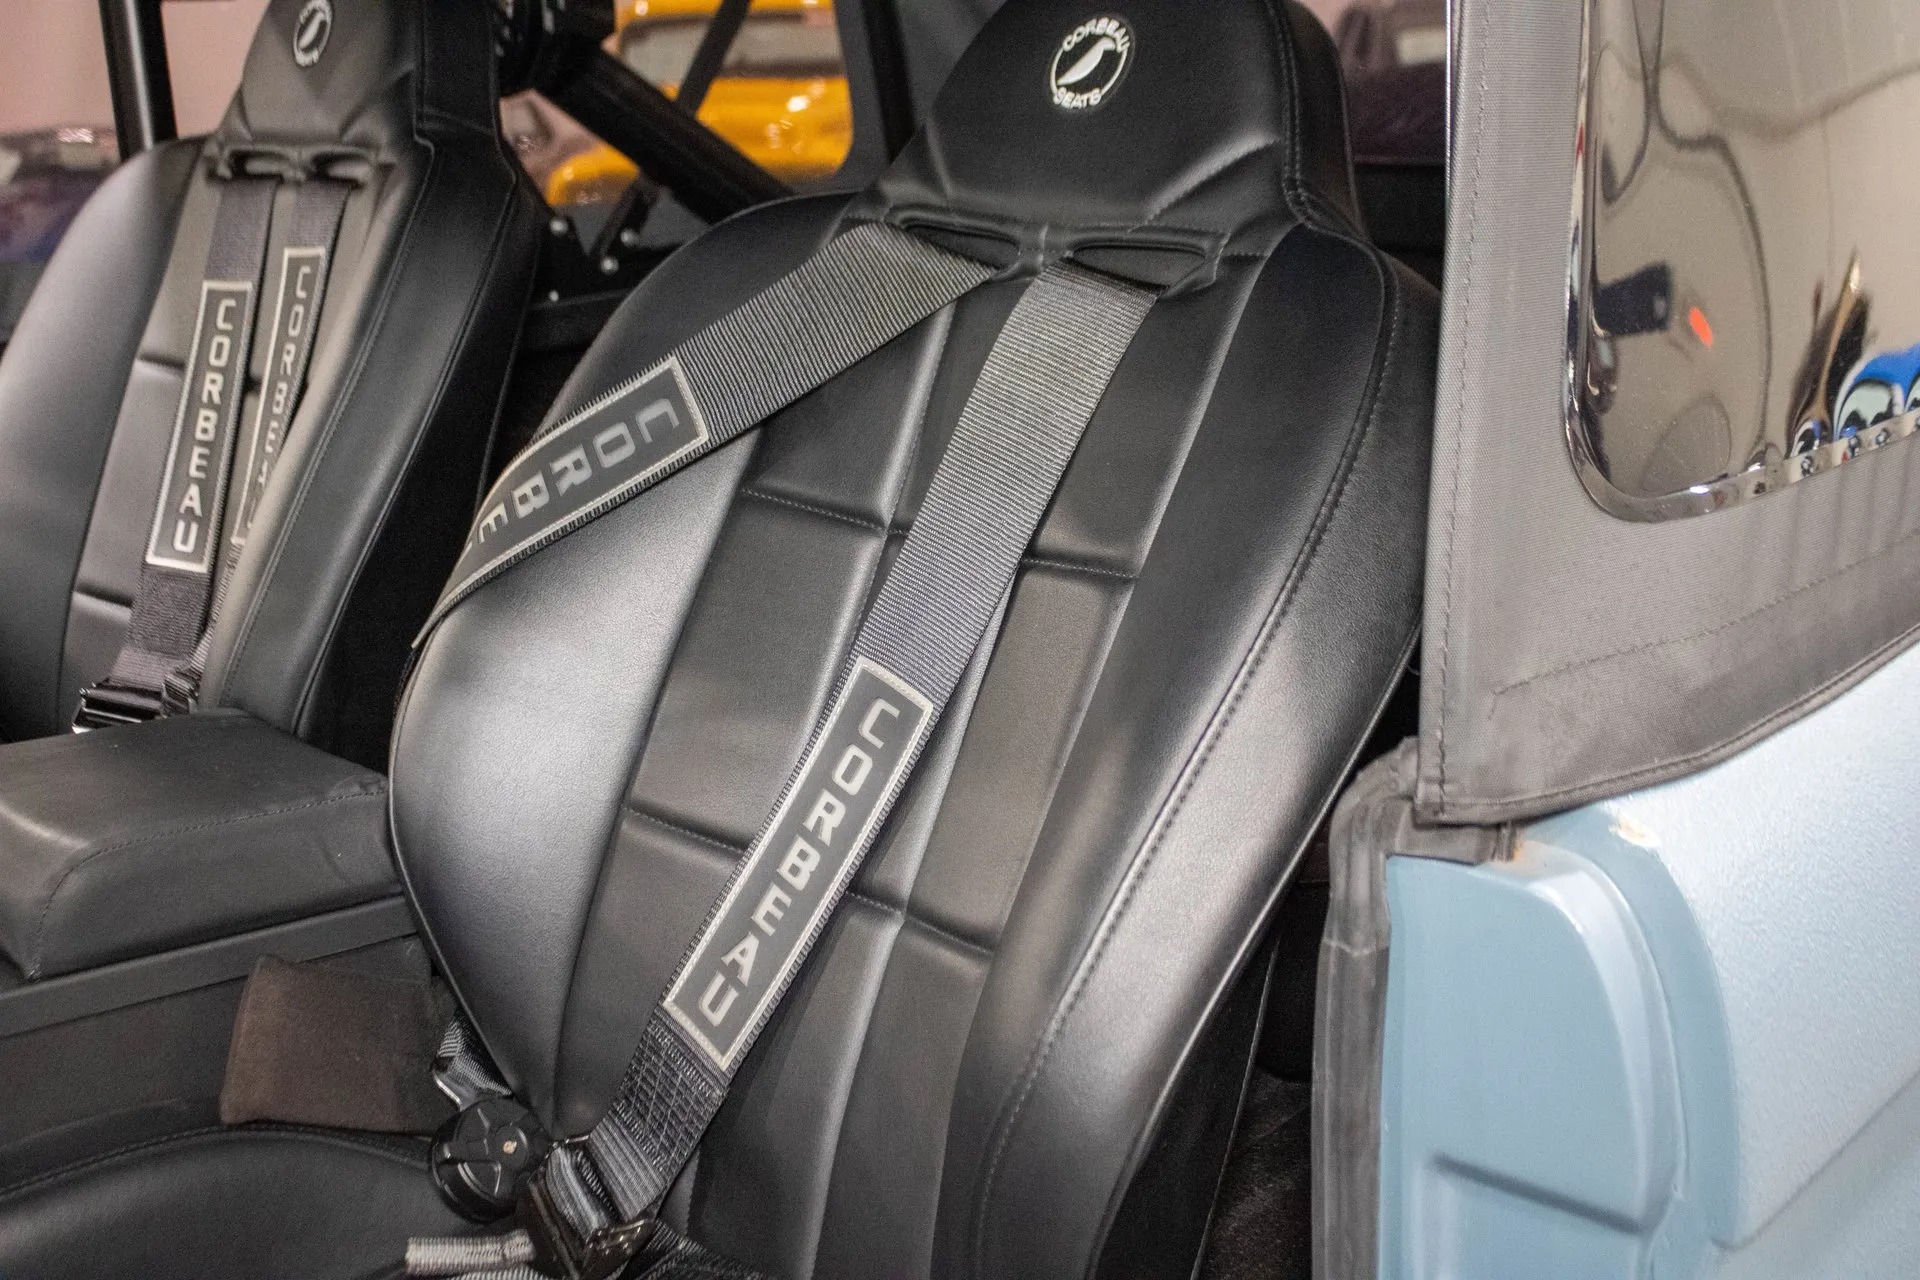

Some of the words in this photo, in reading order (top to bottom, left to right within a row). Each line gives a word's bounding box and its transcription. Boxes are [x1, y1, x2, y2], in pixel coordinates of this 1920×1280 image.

[1053, 86, 1102, 109] SEATS
[1062, 17, 1130, 53] CORBEAU
[173, 299, 236, 553] CORBEAU
[460, 398, 680, 560] CORBE
[700, 698, 900, 1027] CORBEAU
